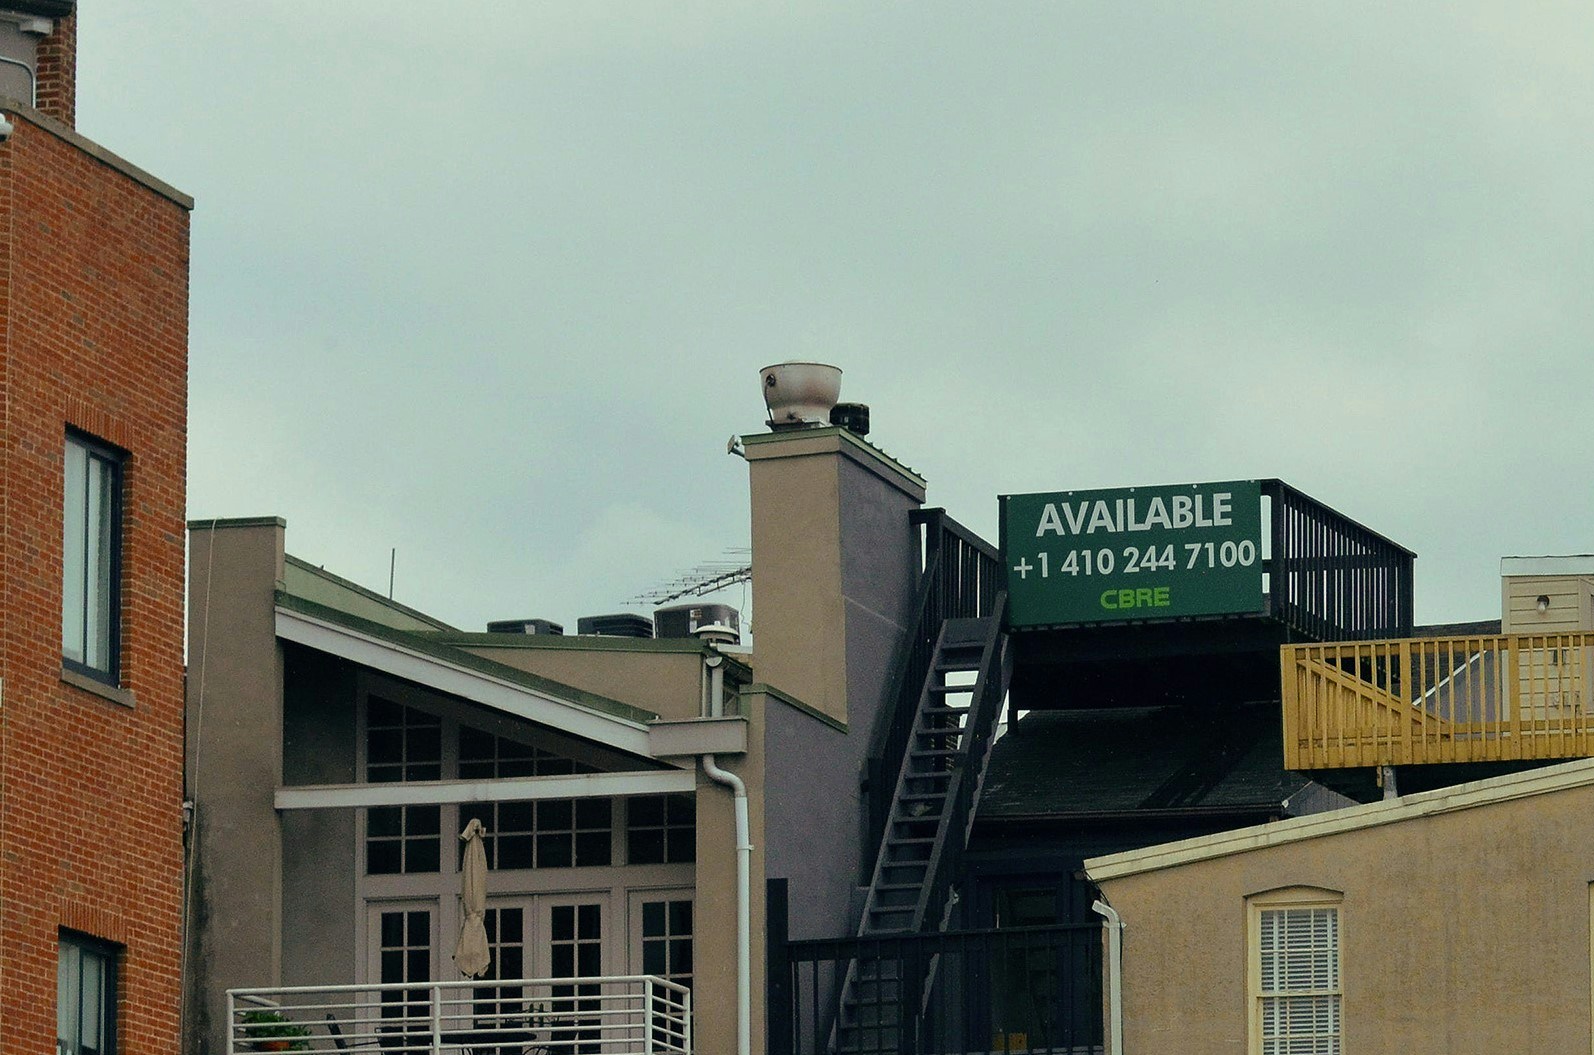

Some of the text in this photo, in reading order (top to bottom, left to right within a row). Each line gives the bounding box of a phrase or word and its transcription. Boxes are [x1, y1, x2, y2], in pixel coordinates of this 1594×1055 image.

[1035, 492, 1233, 537] AVAILABLE
[1013, 539, 1256, 580] +1 410 244 7100
[1100, 587, 1171, 610] CBRE
